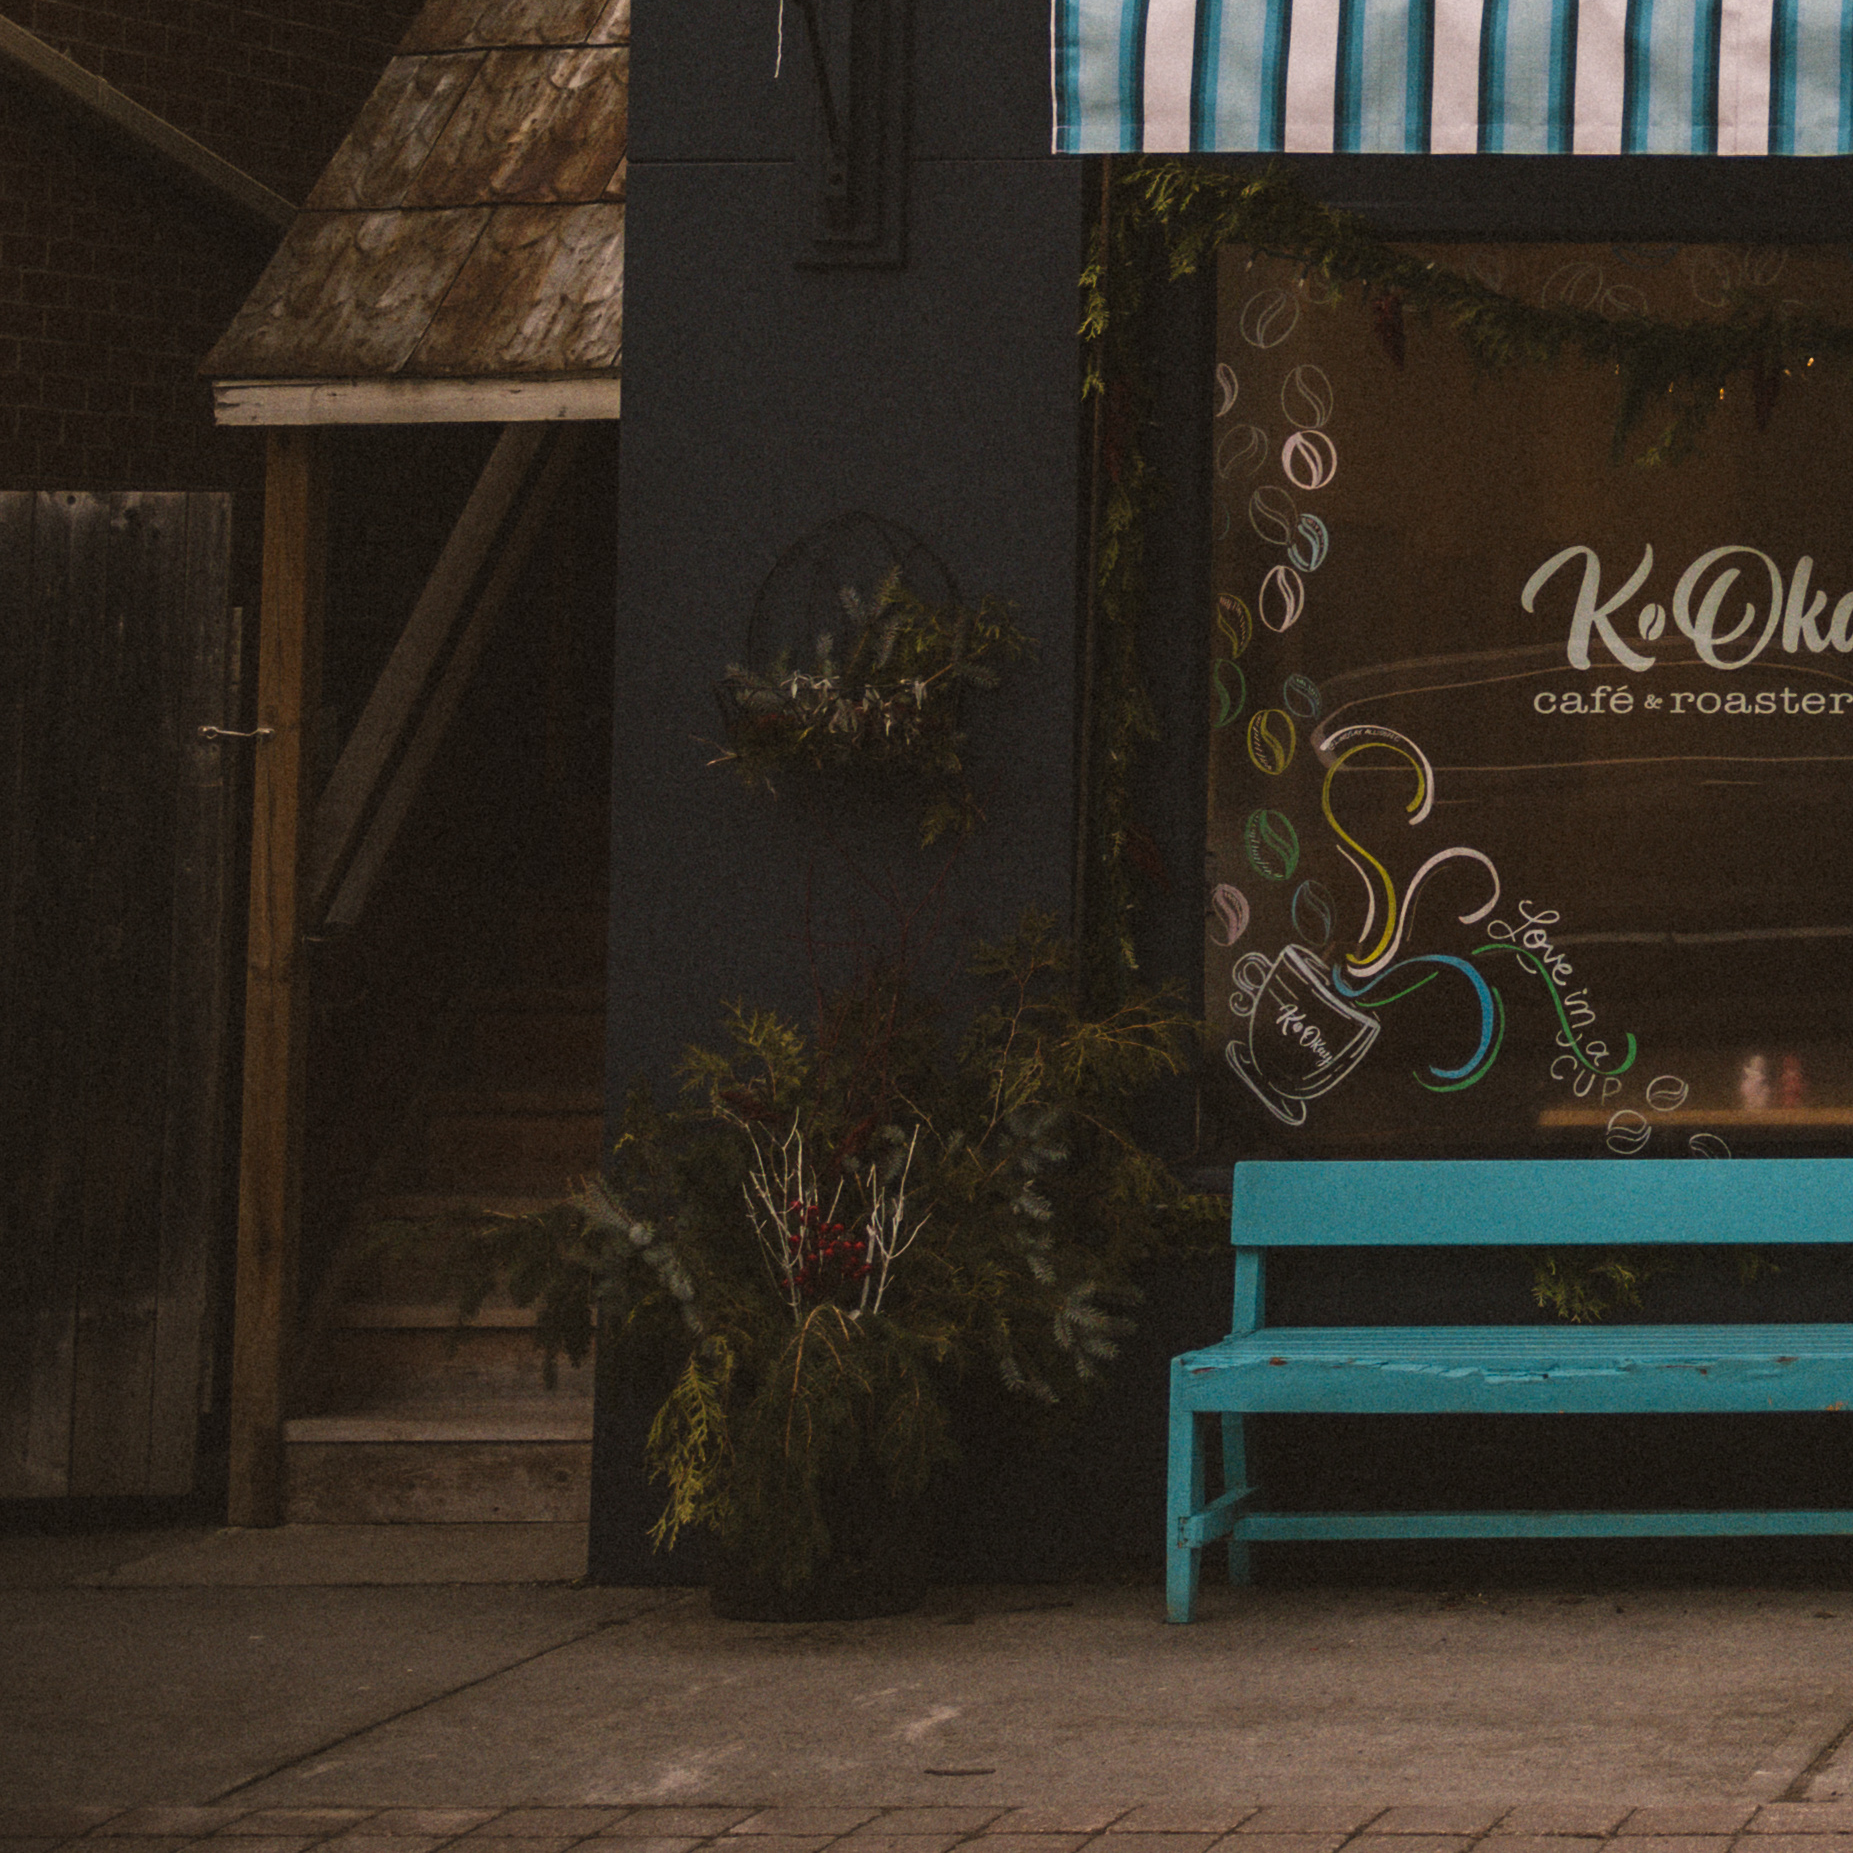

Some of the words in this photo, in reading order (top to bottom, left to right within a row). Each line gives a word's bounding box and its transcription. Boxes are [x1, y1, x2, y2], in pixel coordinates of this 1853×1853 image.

[1533, 685, 1634, 715] café
[1644, 693, 1663, 709] &
[1487, 900, 1573, 986] Love
[1563, 988, 1597, 1032] in
[1586, 1040, 1611, 1066] a
